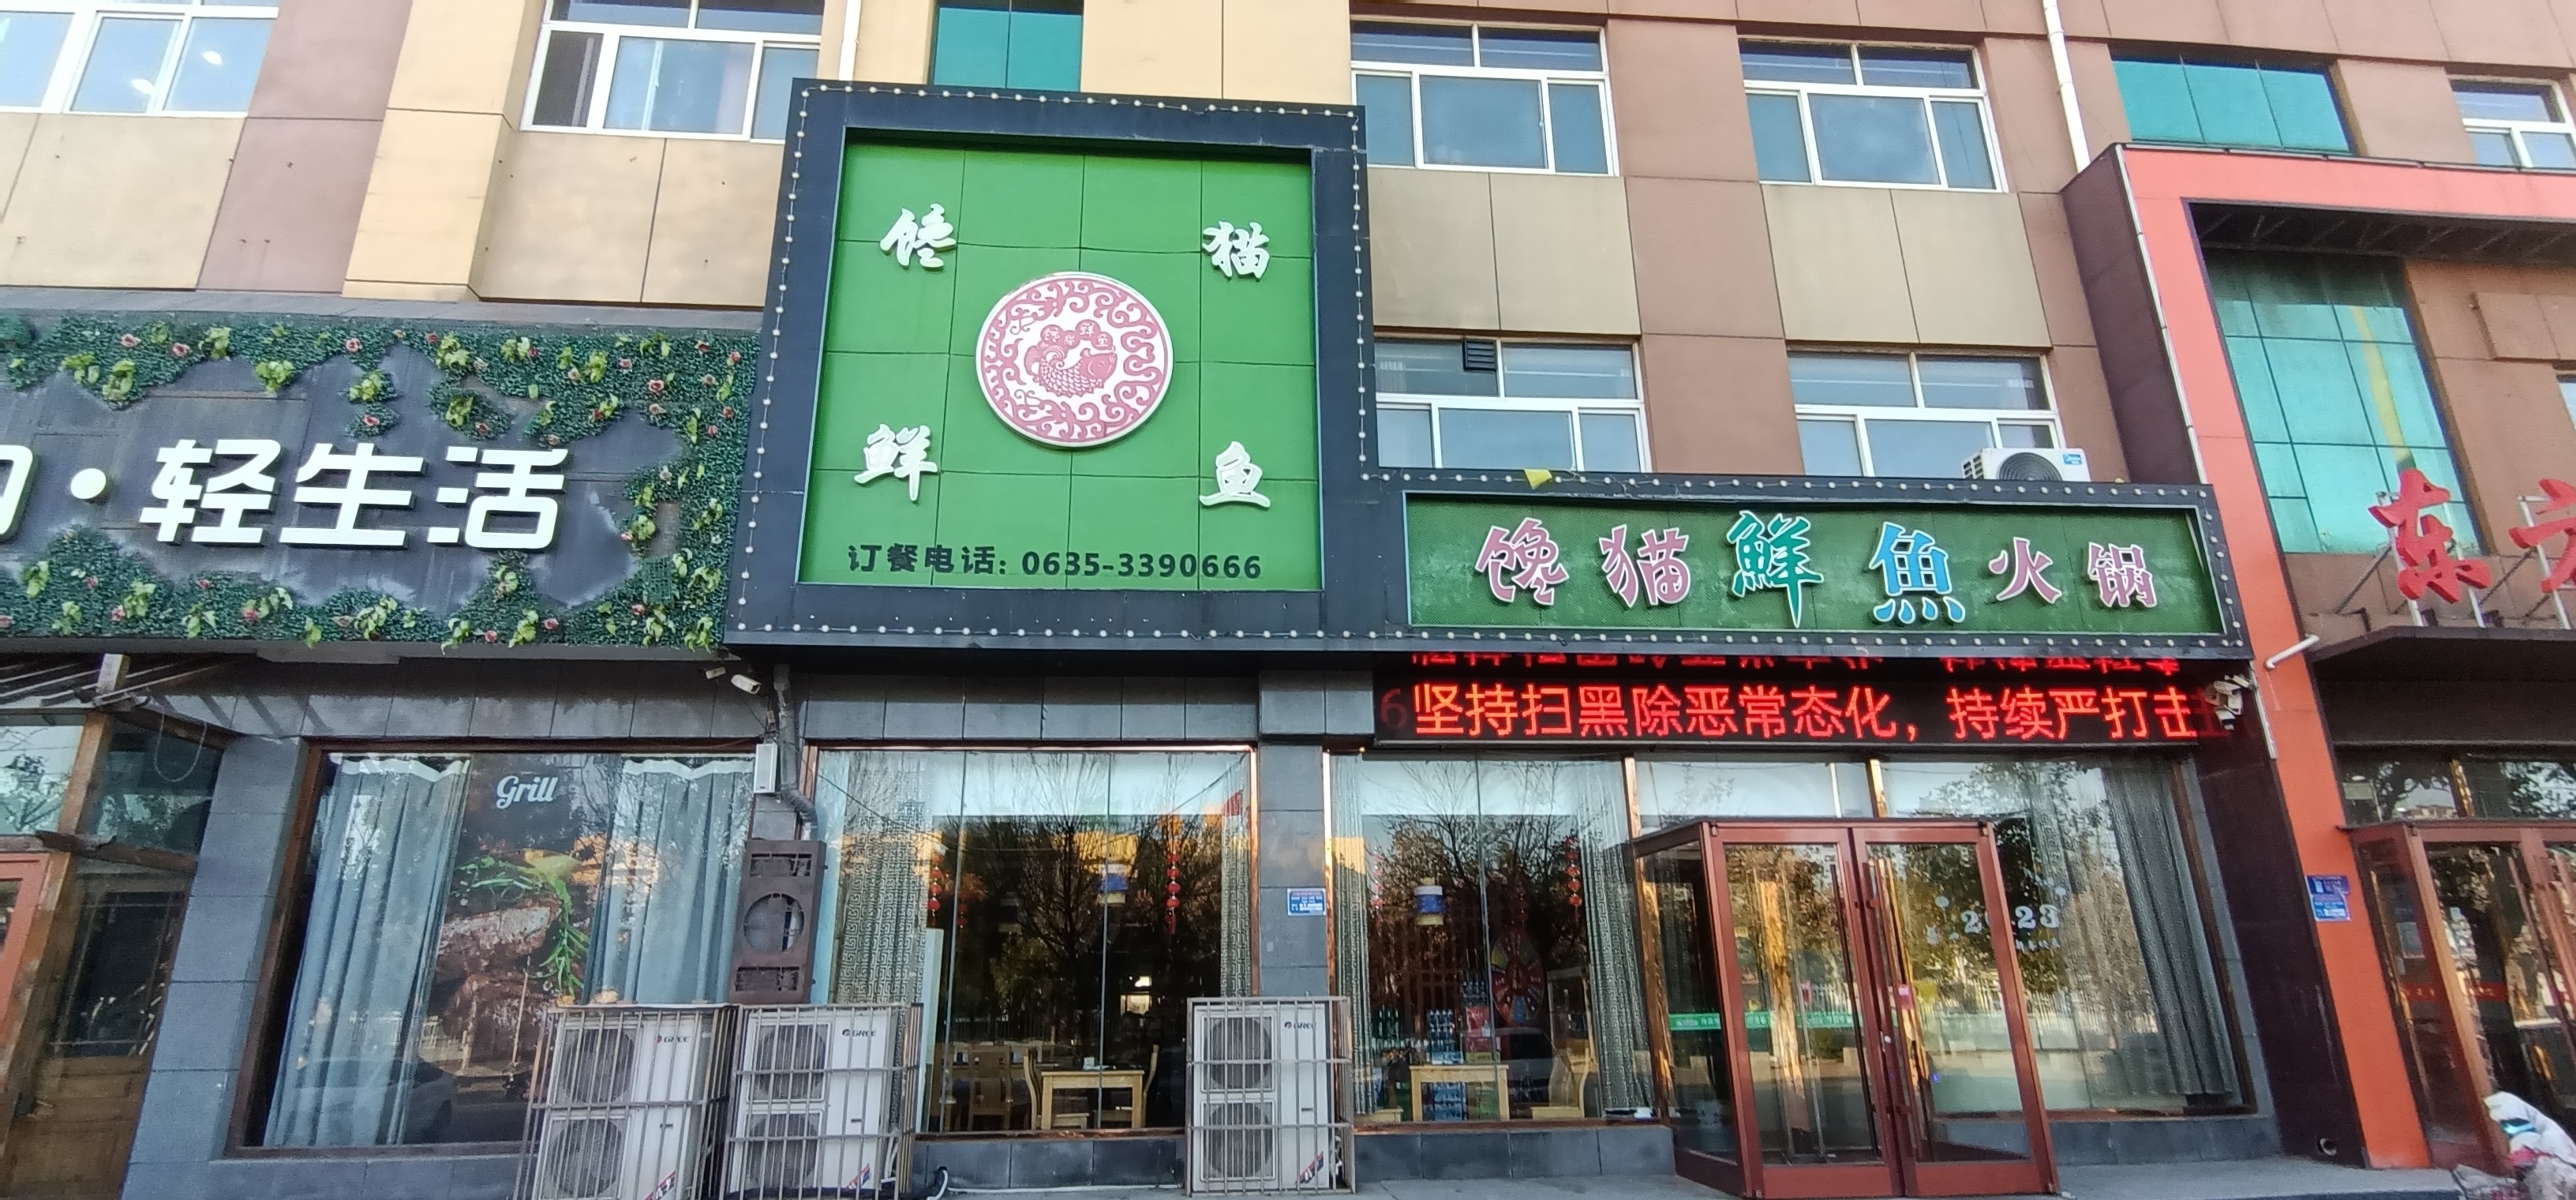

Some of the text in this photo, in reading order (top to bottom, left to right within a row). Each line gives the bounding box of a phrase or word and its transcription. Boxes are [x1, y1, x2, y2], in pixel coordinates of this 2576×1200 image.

[1202, 221, 1270, 278] 猫
[0, 439, 568, 549] ·轻生活
[854, 424, 1270, 507] 鲜 鱼
[496, 775, 559, 809] Grill
[1960, 904, 2061, 935] 223
